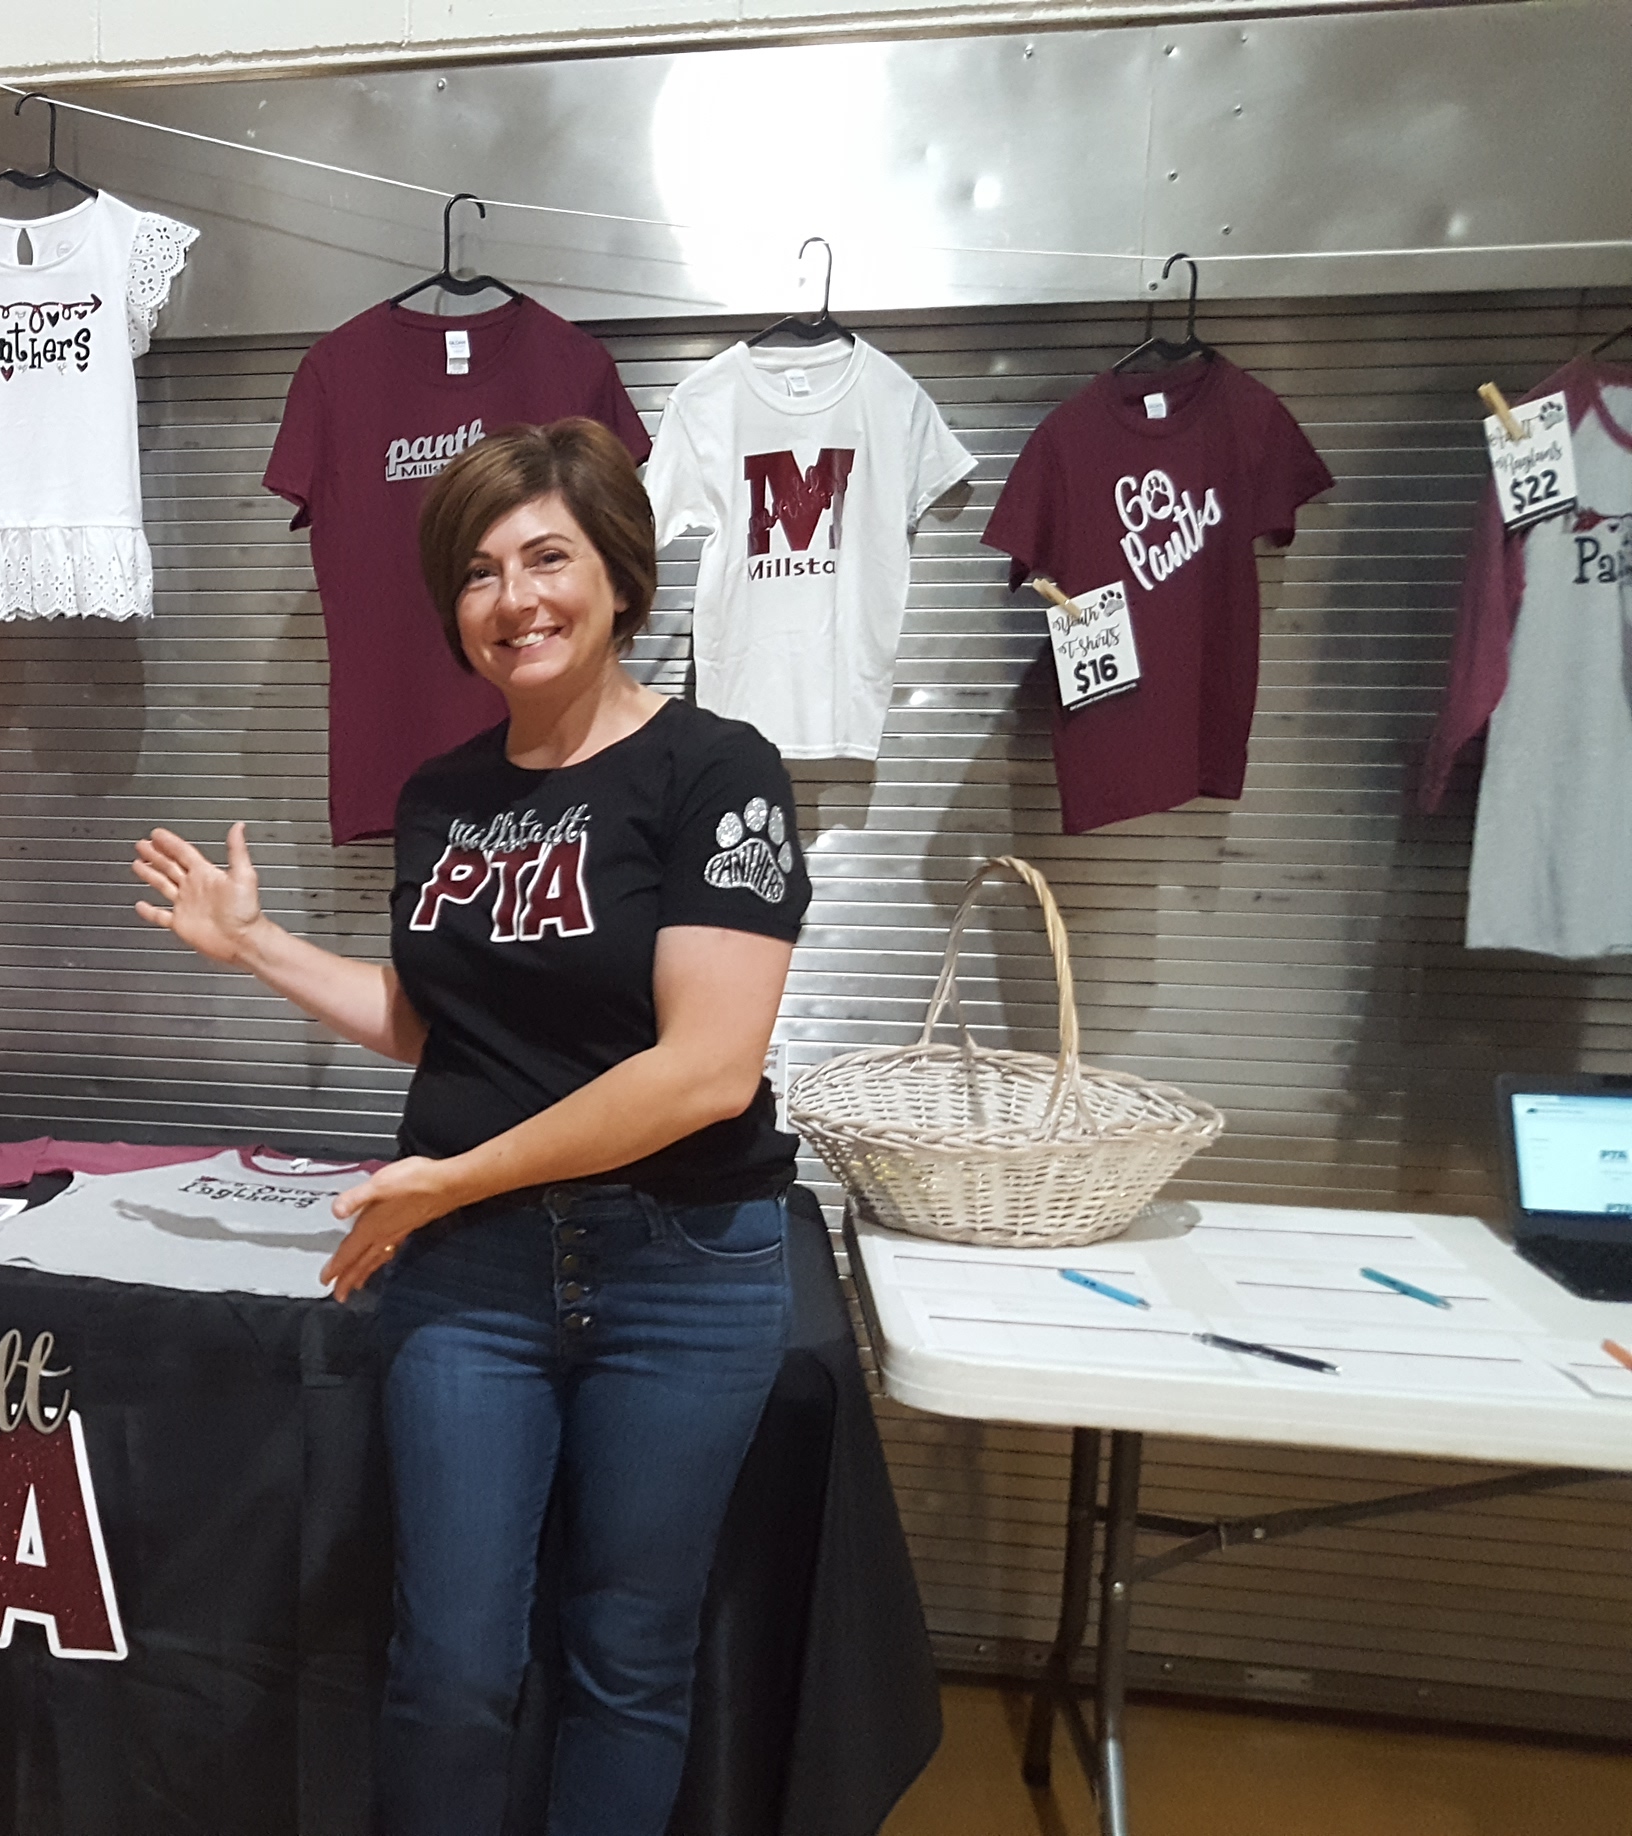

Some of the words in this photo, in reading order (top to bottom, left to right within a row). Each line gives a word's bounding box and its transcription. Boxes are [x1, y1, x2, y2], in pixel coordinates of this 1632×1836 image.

[385, 418, 486, 475] panth
[1510, 470, 1559, 513] $22
[748, 558, 835, 581] Millsta
[1074, 654, 1118, 694] $16
[448, 803, 591, 853] Millstadt
[409, 832, 595, 942] PTA
[708, 841, 783, 900] PANTHERS
